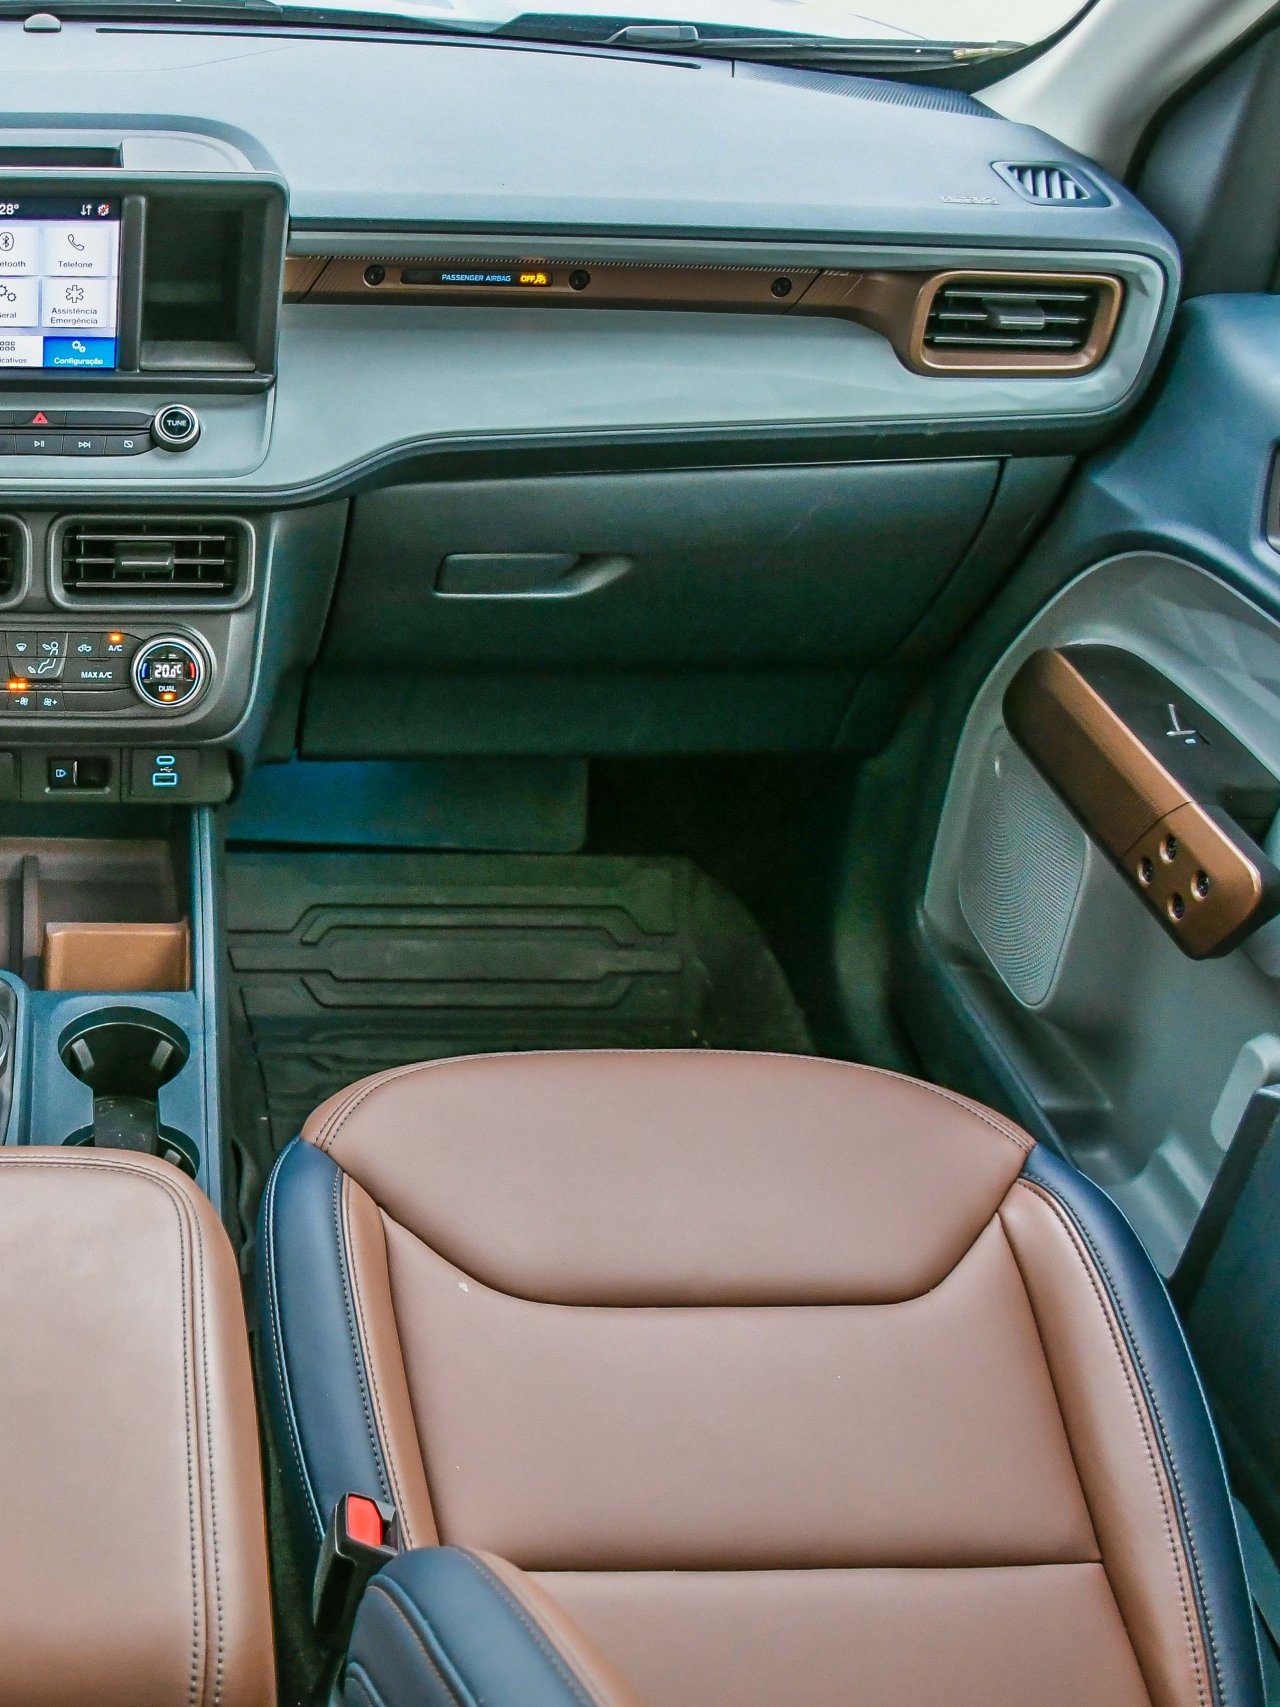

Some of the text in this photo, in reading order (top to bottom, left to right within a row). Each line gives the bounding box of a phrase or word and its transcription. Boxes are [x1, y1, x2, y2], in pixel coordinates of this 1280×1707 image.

[520, 274, 536, 283] OFF
[51, 307, 98, 315] Assistência
[50, 316, 98, 325] Emergência
[53, 357, 104, 366] Configuração
[167, 419, 187, 428] TUNE
[80, 671, 113, 679] MAX A/C
